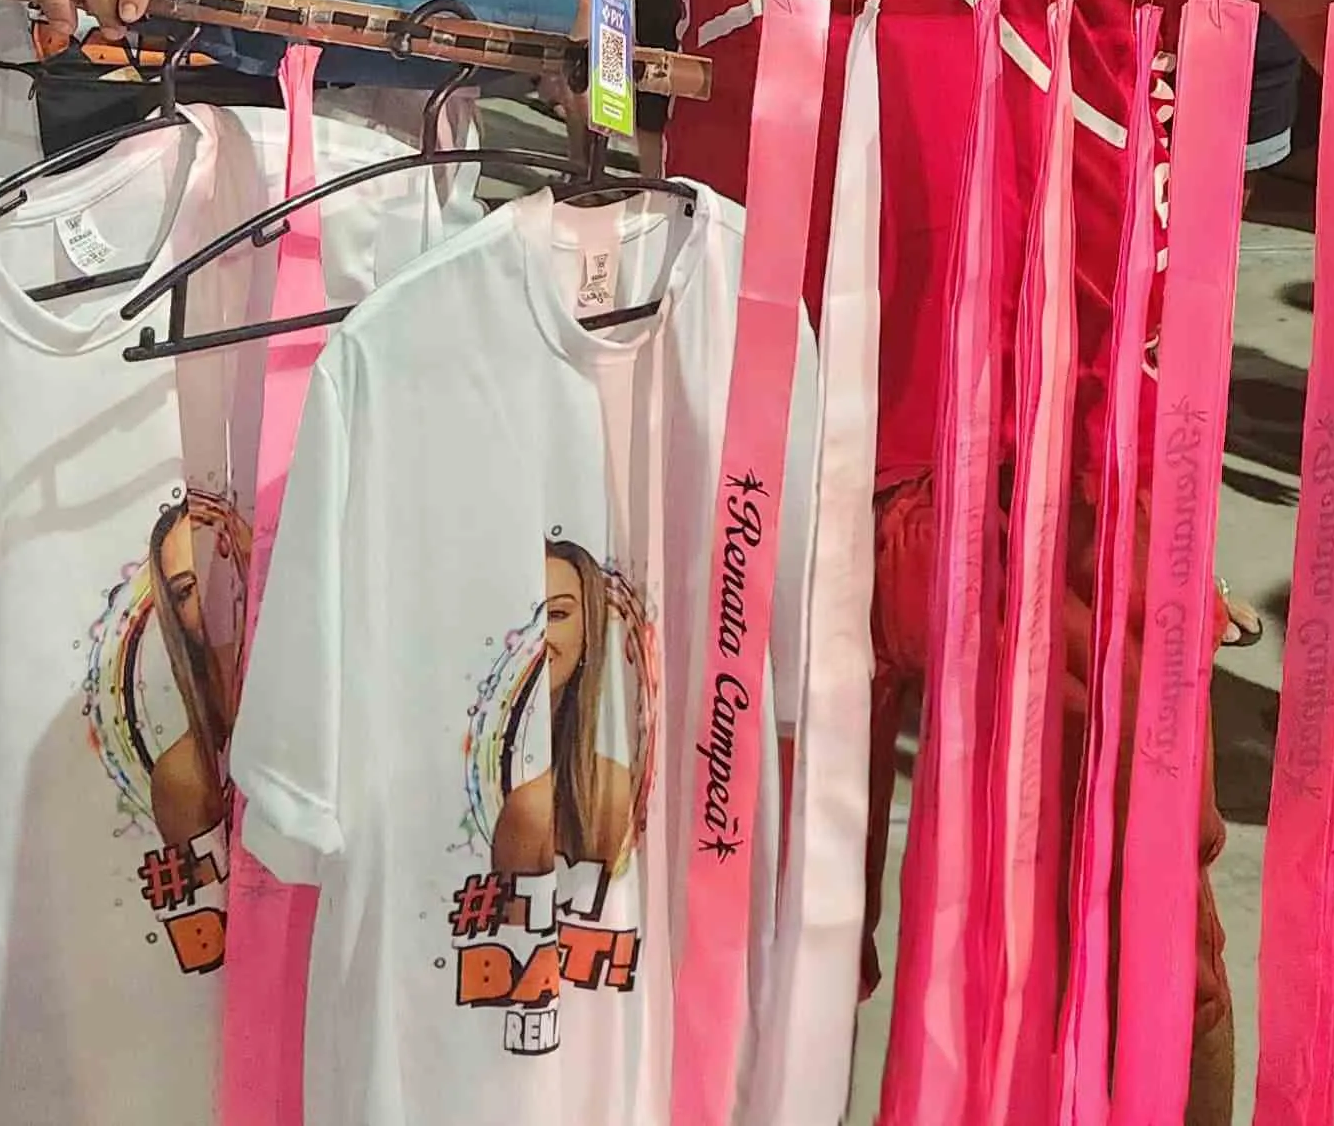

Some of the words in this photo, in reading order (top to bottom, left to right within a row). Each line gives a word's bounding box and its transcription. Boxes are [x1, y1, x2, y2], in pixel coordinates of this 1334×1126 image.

[610, 10, 625, 28] PIX
[718, 496, 763, 658] Renata
[697, 673, 749, 836] Campeã
